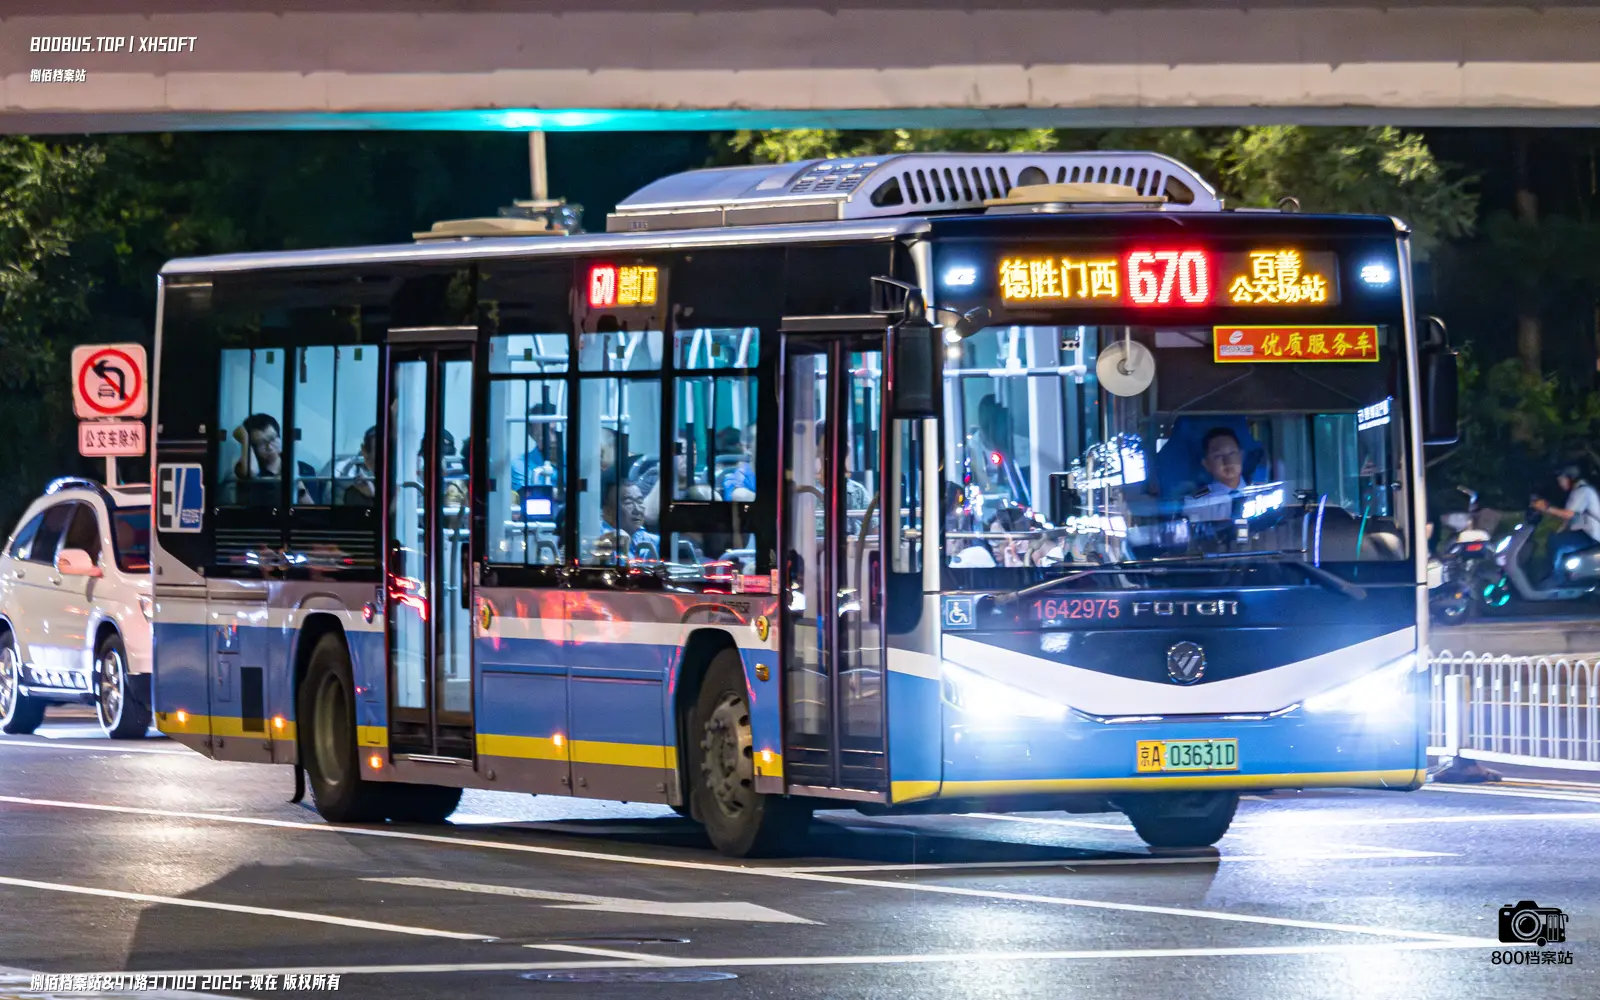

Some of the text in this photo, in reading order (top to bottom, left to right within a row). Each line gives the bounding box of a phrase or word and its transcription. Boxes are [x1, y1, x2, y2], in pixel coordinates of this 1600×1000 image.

[1000, 251, 1209, 303] 德胜门西 670
[1249, 249, 1301, 280] 百善
[1229, 275, 1326, 303] 公交场站
[1260, 331, 1373, 357] 优质服务车
[85, 429, 141, 449] 公交车除外
[1033, 600, 1239, 620] 1642975 FOTON
